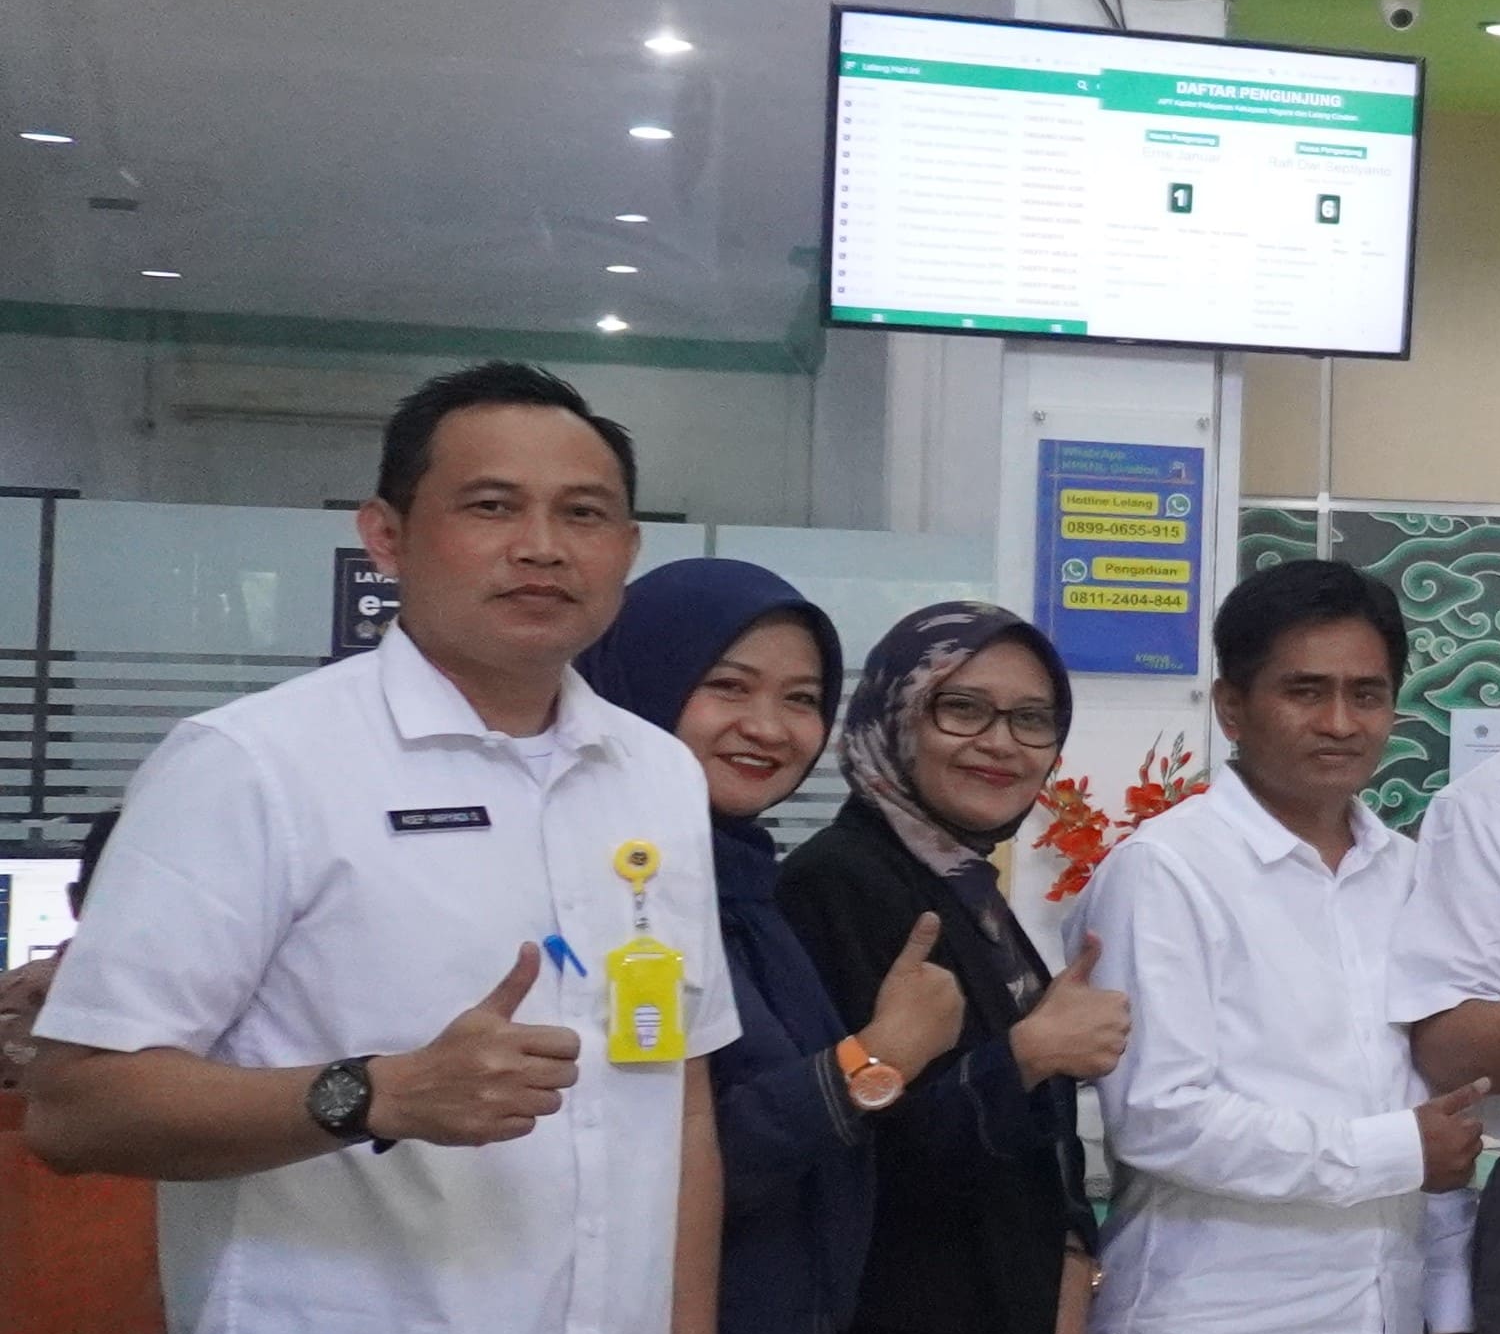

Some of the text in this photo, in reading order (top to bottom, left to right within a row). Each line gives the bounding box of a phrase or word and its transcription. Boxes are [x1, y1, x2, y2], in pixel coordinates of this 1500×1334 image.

[1175, 81, 1343, 108] DAFTAR PENGUNJUNG
[1173, 189, 1187, 207] 1
[1321, 199, 1335, 218] 6
[1066, 494, 1153, 510] Hotline Lelang
[1105, 563, 1177, 577] Pengaduan
